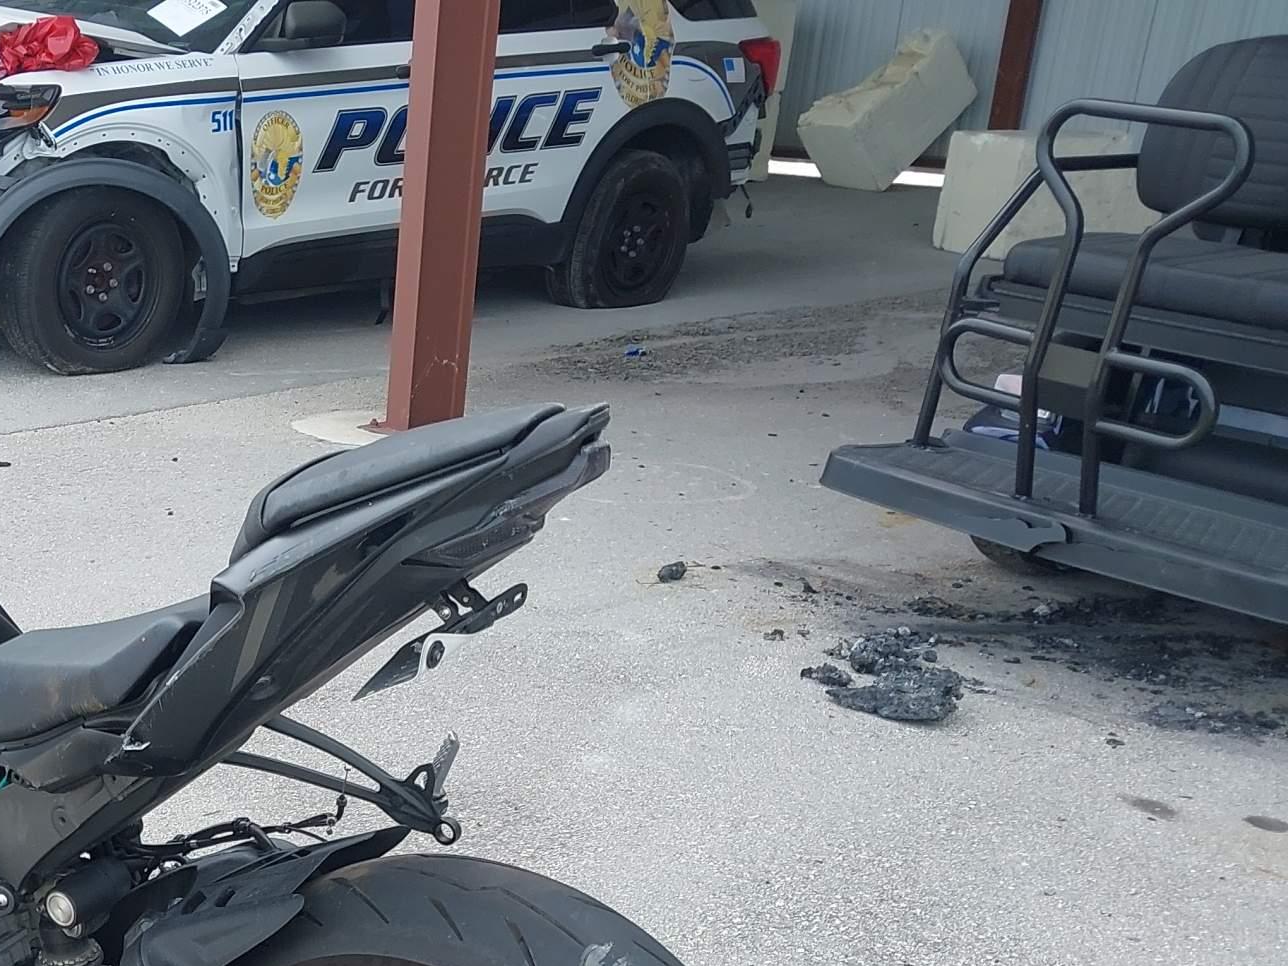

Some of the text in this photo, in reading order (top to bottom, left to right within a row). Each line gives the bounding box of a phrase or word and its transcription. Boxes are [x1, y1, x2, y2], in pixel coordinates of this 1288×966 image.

[112, 61, 154, 75] HONOR
[155, 59, 175, 71] WE
[211, 109, 234, 133] 511
